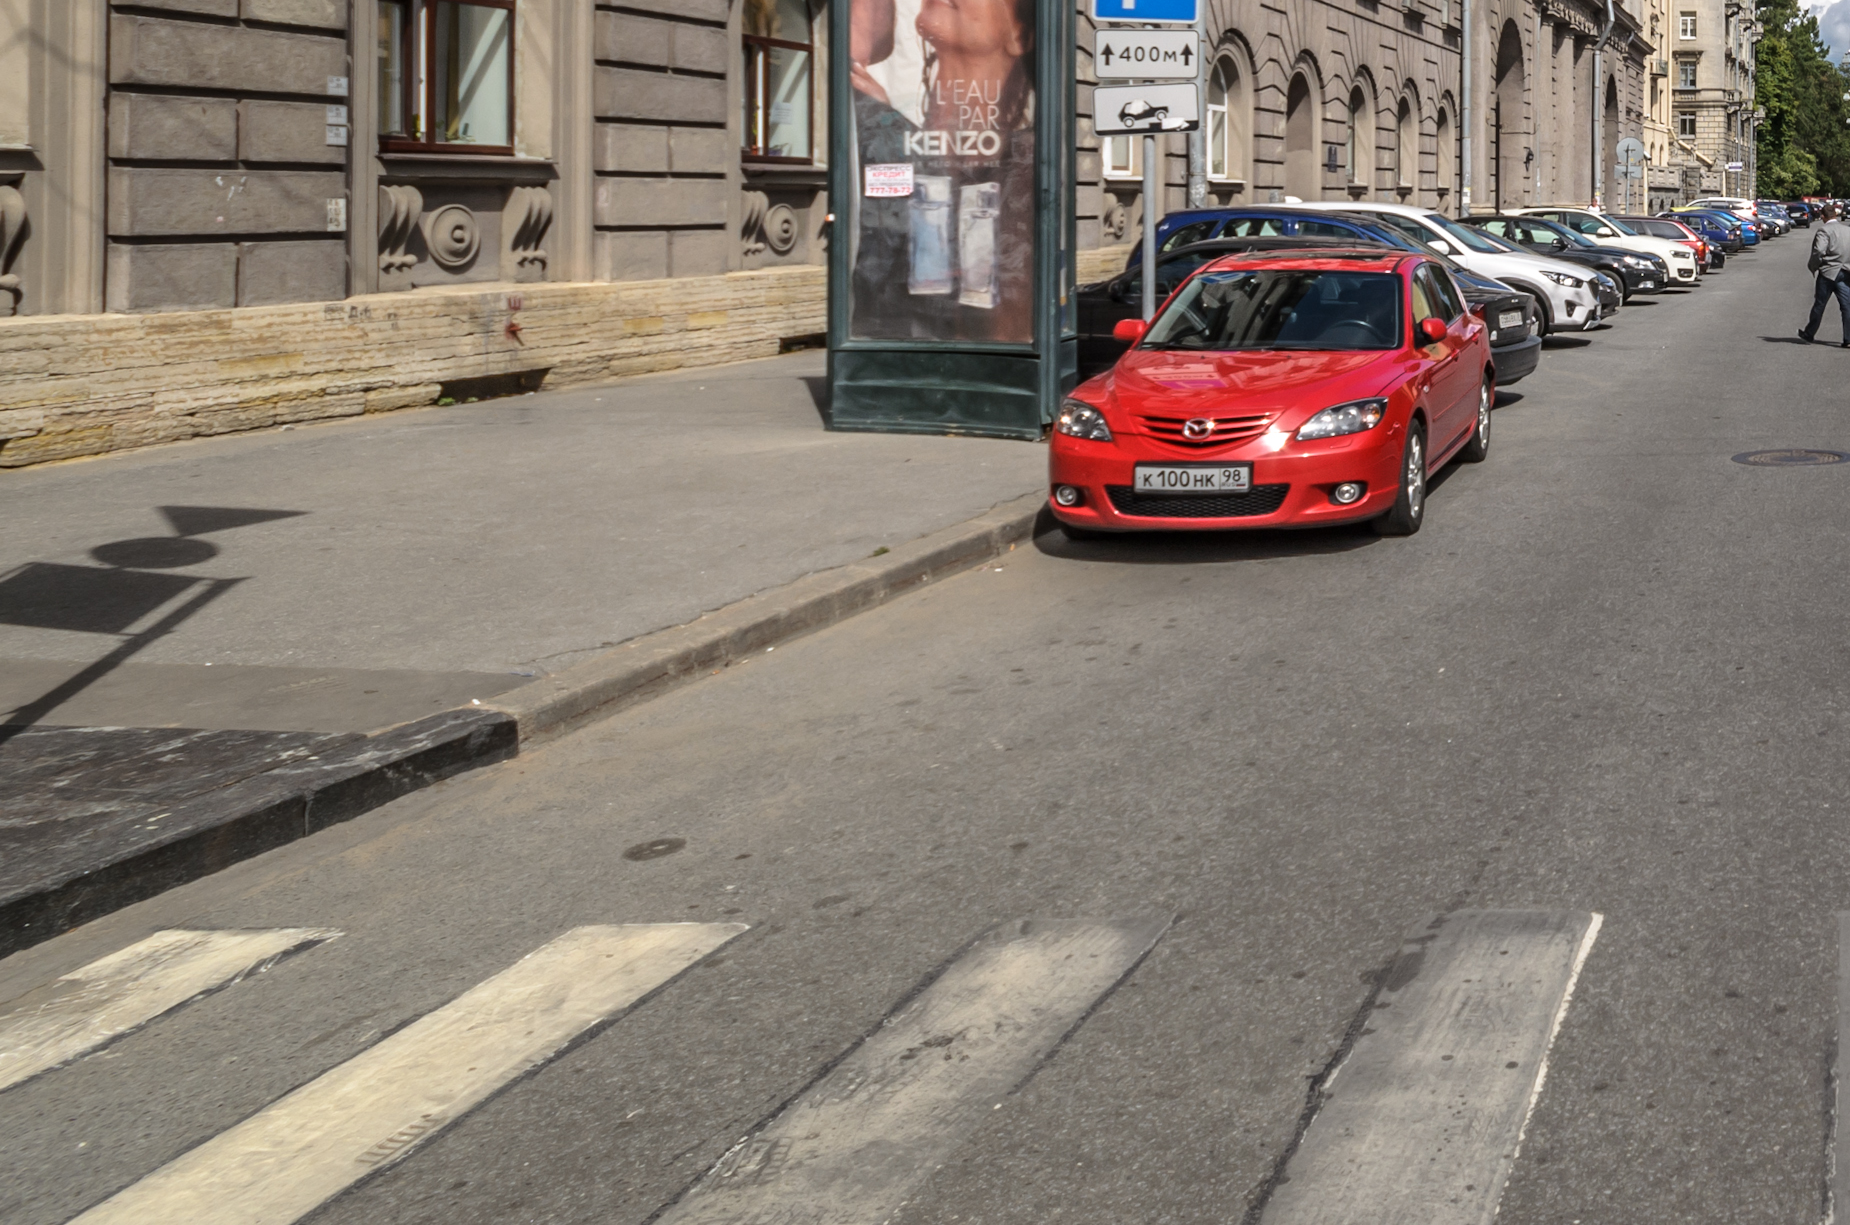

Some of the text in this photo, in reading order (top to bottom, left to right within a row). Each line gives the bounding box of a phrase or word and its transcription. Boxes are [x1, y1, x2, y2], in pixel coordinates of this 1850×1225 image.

[936, 78, 1000, 105] L'EAU
[959, 105, 1000, 130] PAR
[904, 130, 1001, 156] KENZO
[1222, 469, 1242, 483] 98
